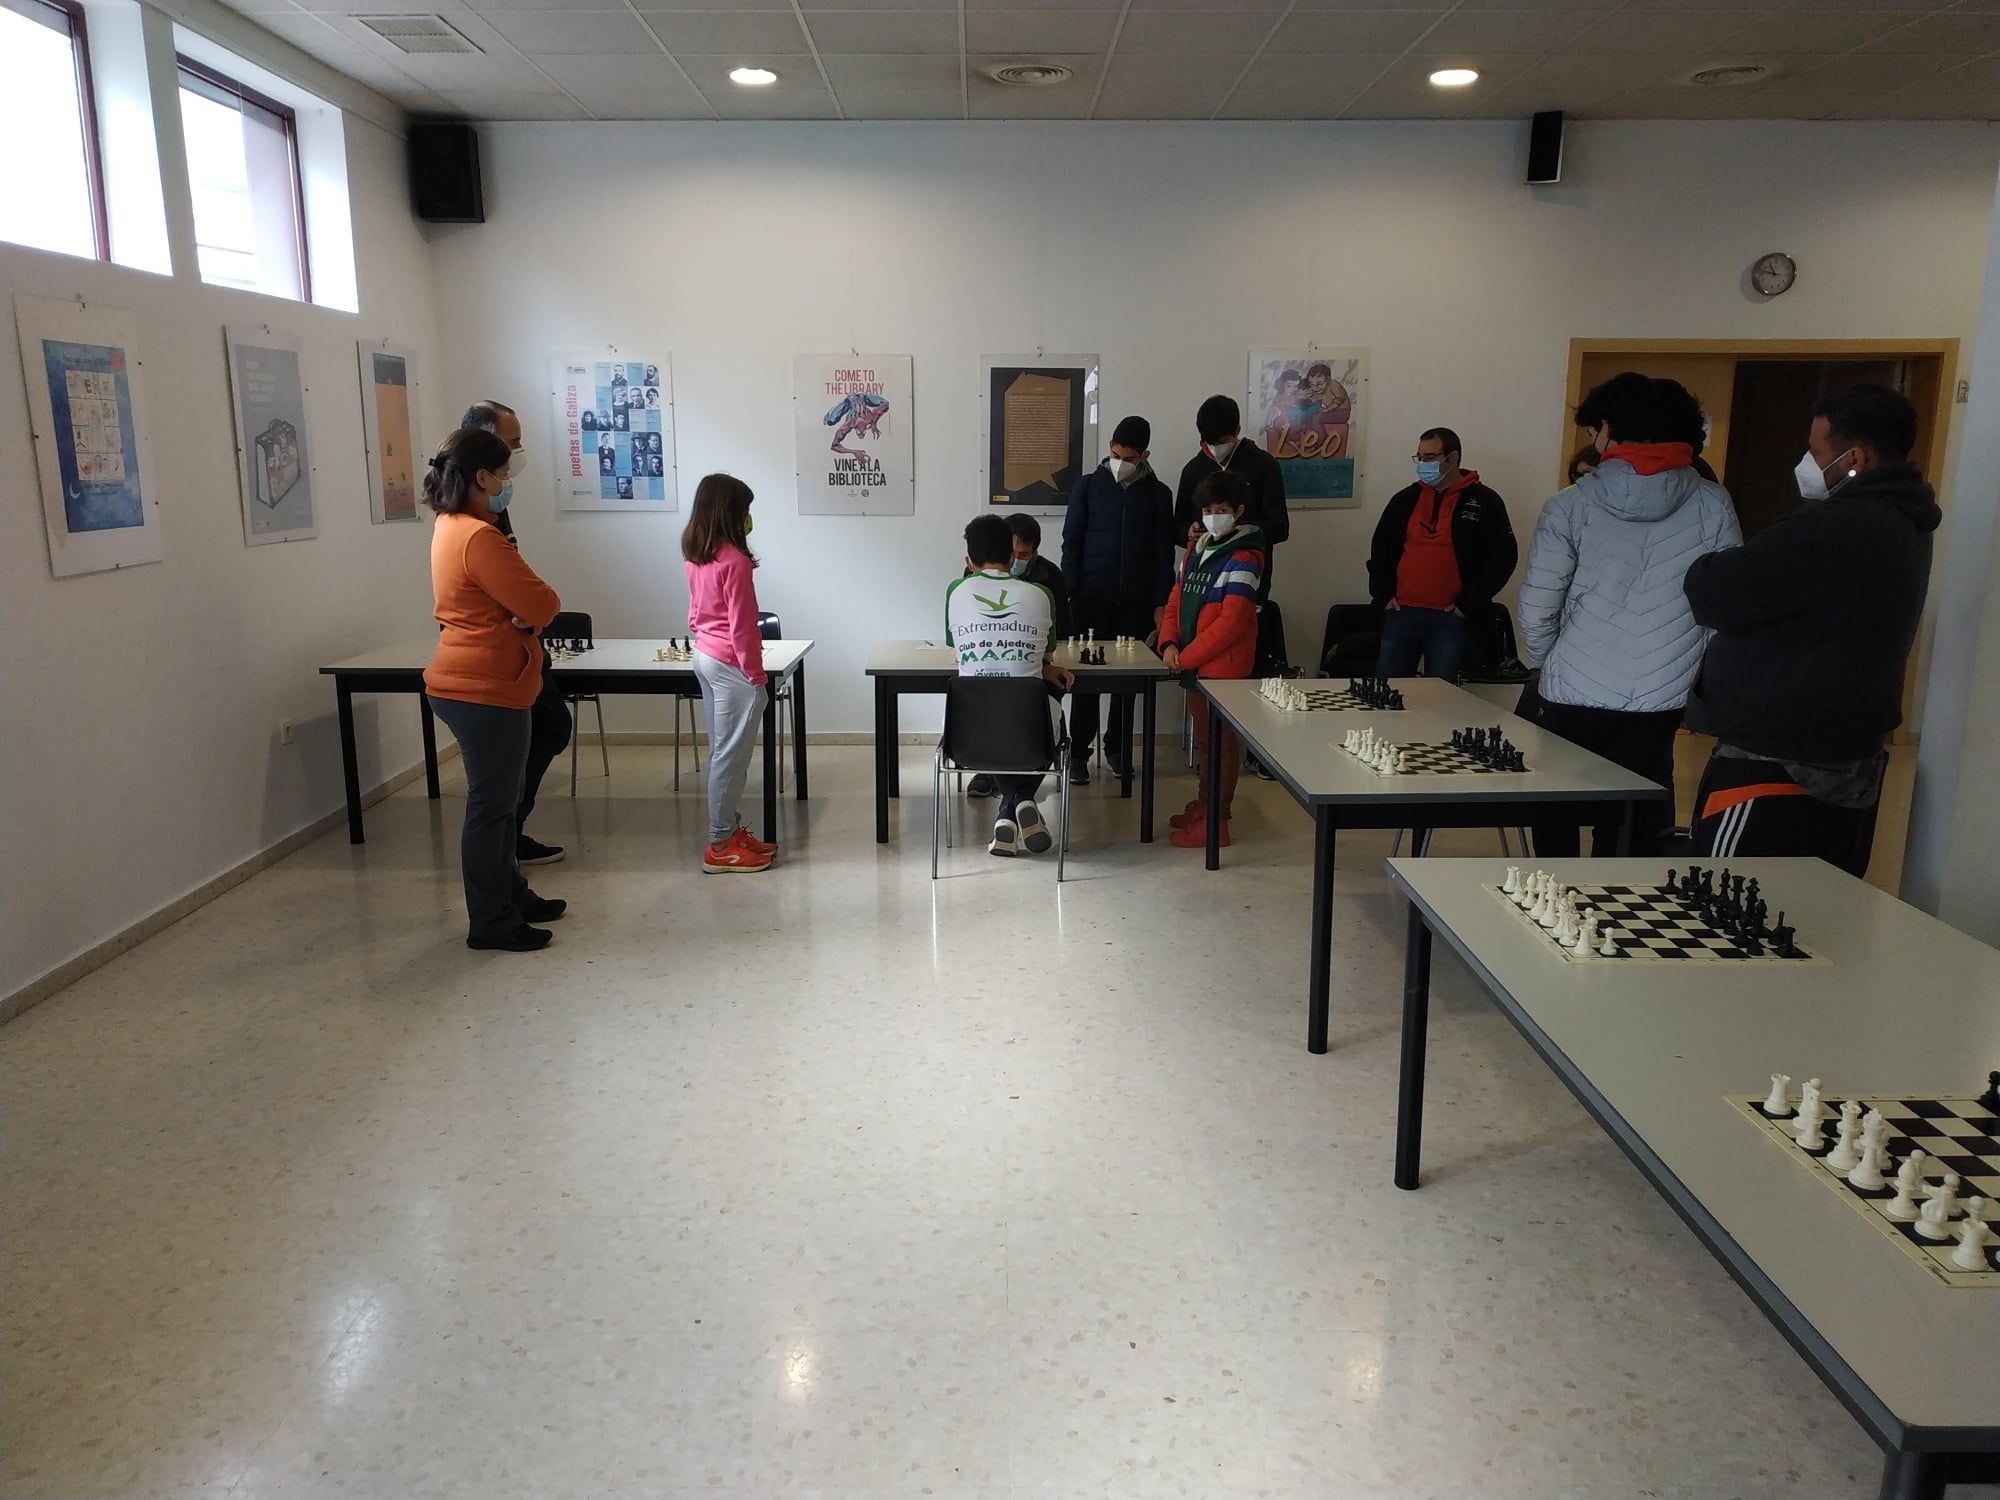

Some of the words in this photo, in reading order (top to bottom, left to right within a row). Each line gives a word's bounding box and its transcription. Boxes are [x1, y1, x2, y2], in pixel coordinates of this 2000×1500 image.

[834, 369, 861, 382] COME
[863, 369, 875, 382] TO
[825, 382, 844, 395] THE
[844, 382, 885, 395] LIBRARY
[566, 385, 578, 418] Galiza
[568, 421, 579, 435] de
[1273, 423, 1342, 459] Leo
[570, 439, 583, 477] poetas
[834, 458, 858, 472] VINE
[868, 458, 881, 472] LA
[828, 472, 887, 486] BIBLIOTECA
[958, 620, 1038, 637] Extremadura
[959, 641, 976, 652] Club
[979, 640, 993, 648] de
[996, 639, 1036, 651] Ajedrez
[961, 648, 1036, 666] MAGIC
